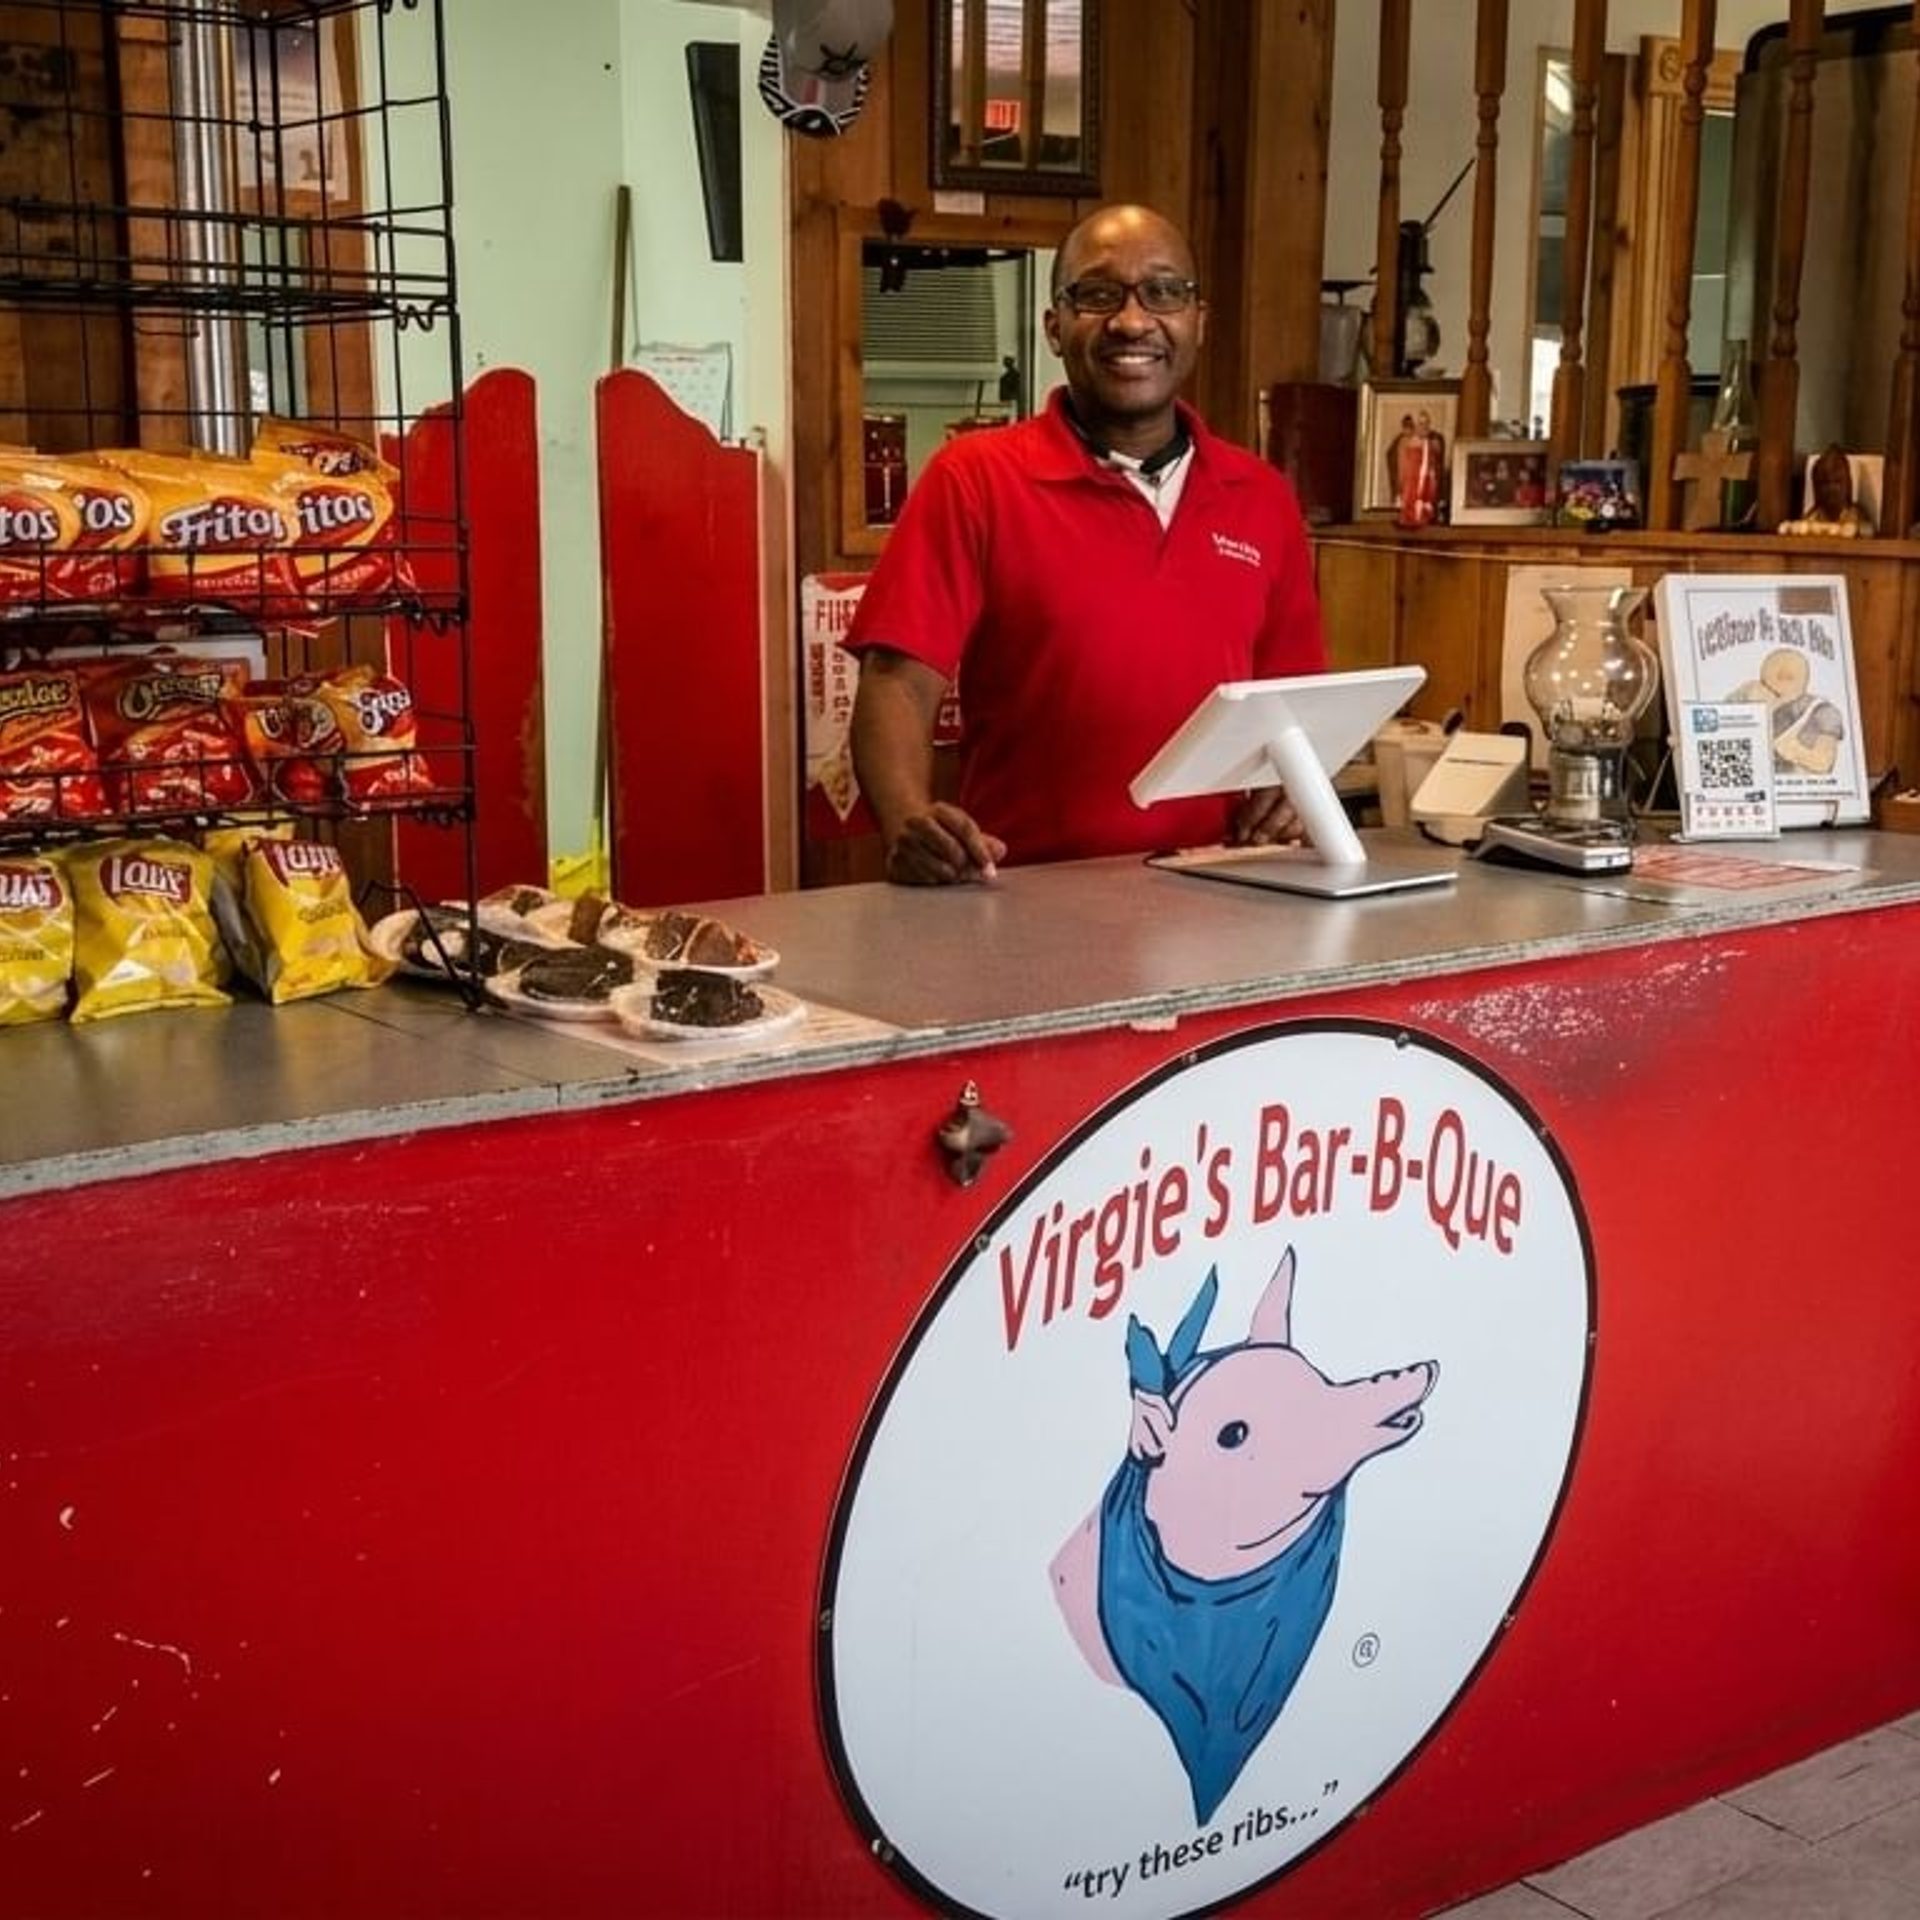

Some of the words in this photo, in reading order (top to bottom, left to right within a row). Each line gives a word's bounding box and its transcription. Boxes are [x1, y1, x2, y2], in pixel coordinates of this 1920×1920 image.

[73, 494, 132, 530] os
[298, 494, 373, 534] itos
[999, 1122, 1232, 1352] Virgie's
[1251, 1097, 1522, 1255] Bar-B-Que
[1138, 1830, 1224, 1881] these
